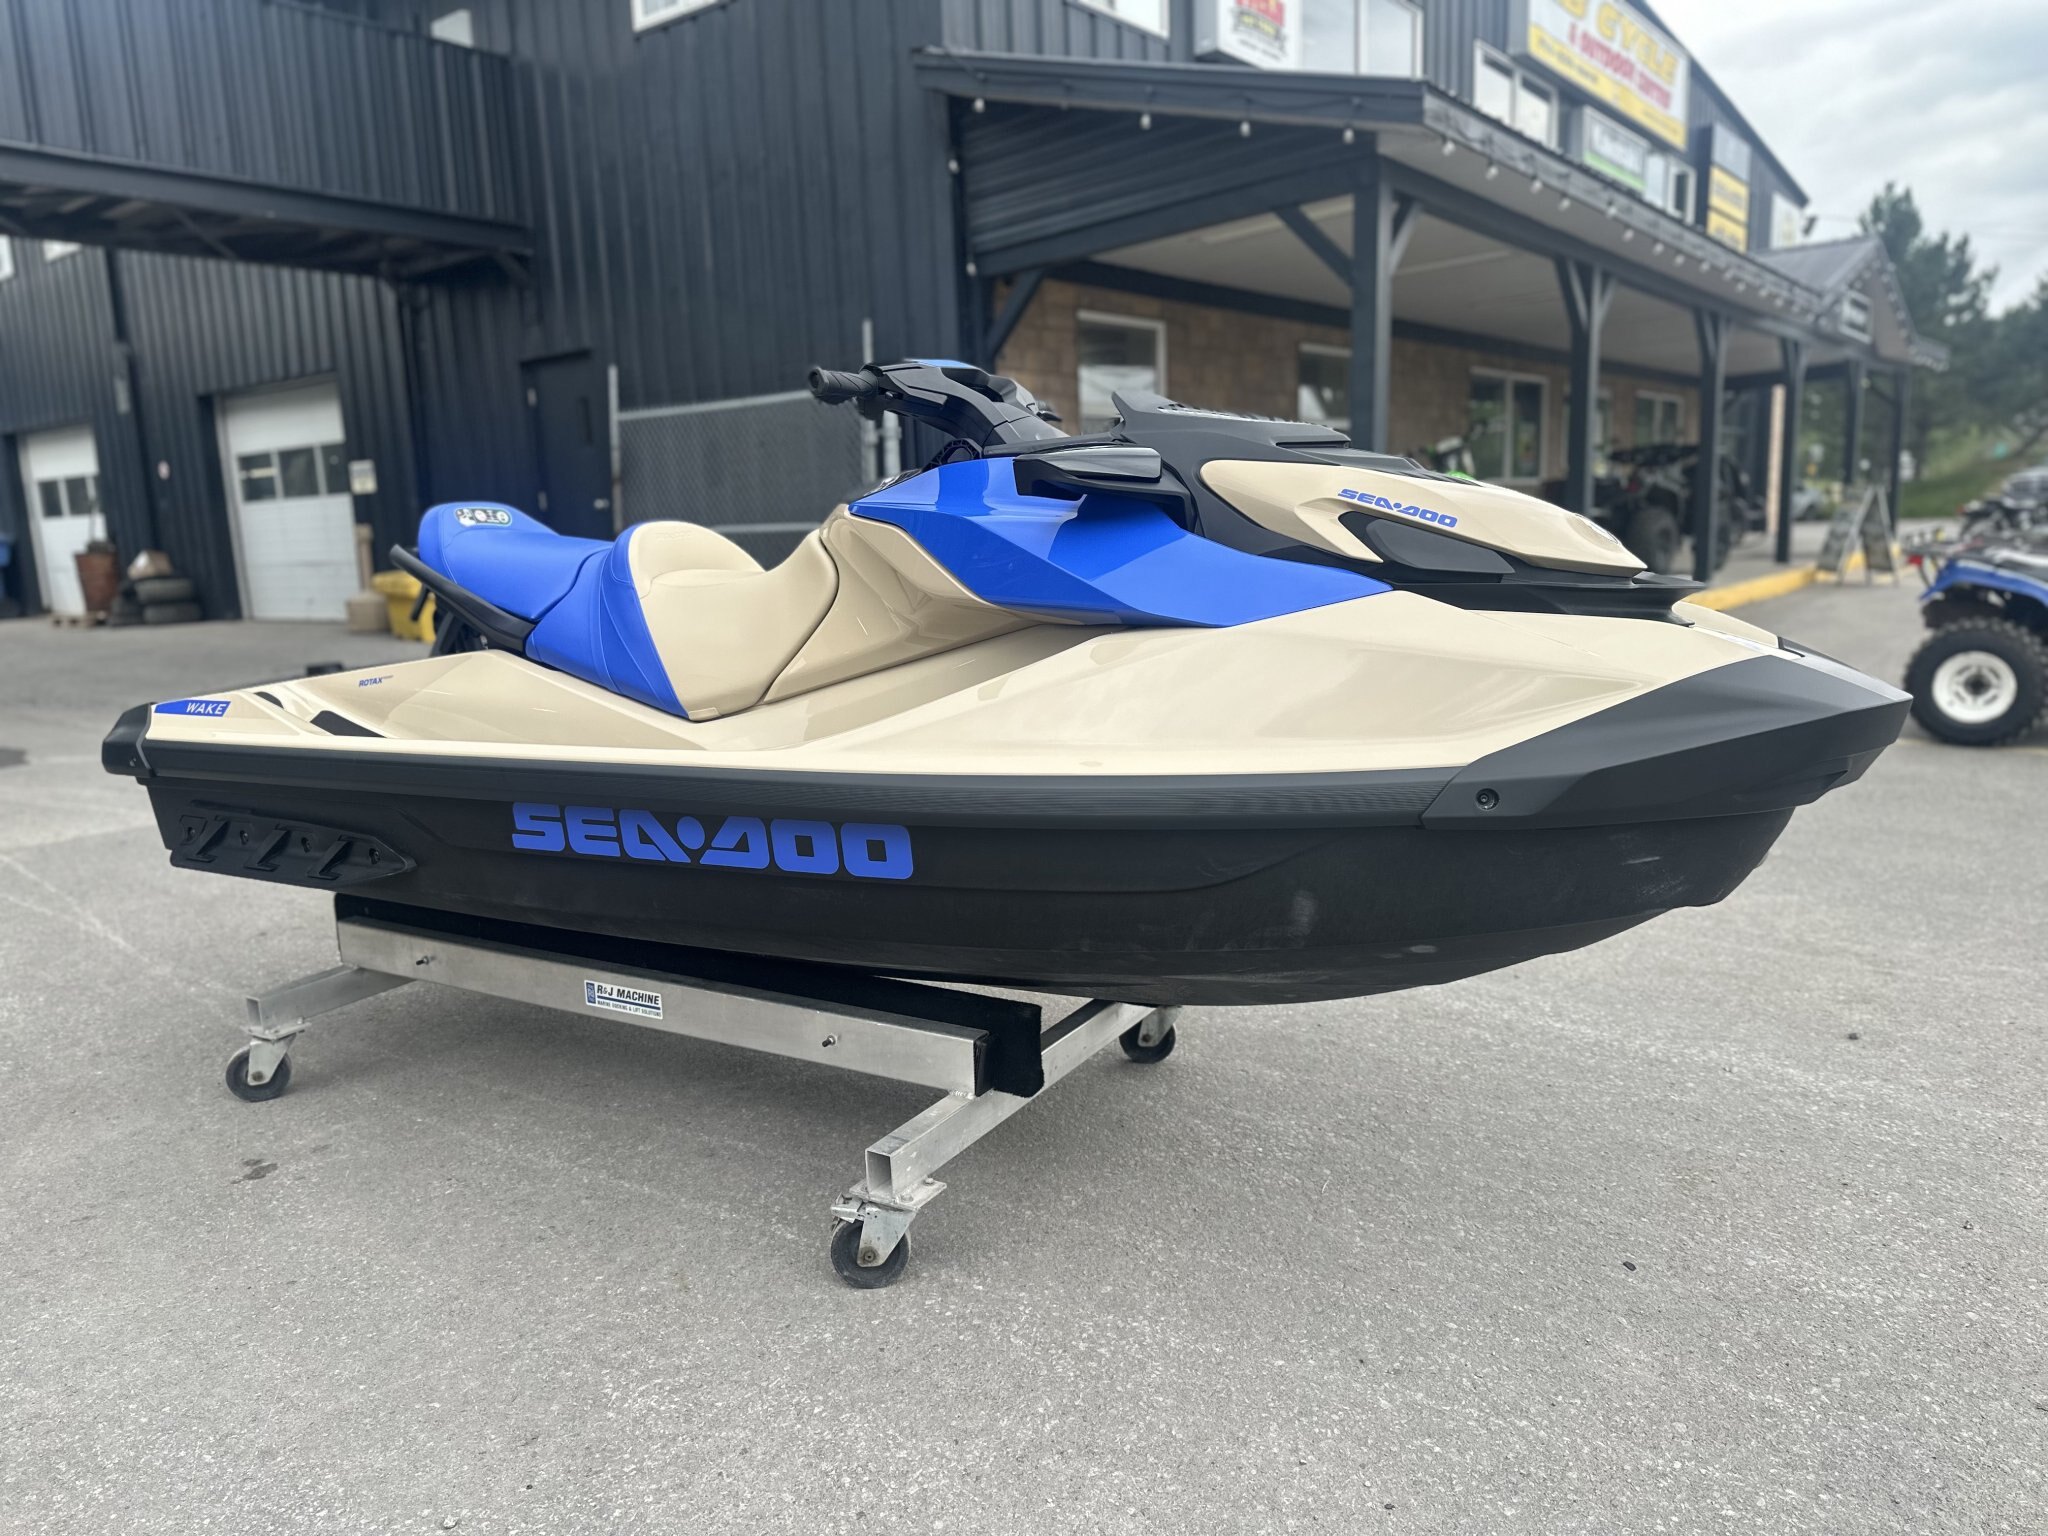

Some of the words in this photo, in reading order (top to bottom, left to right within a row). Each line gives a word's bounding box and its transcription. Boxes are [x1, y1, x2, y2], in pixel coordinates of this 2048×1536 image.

[1596, 3, 1679, 86] CYCLE
[358, 677, 383, 688] ROTAX
[185, 702, 227, 714] WAKE
[597, 984, 614, 997] R&J
[616, 988, 660, 1005] MACHINE
